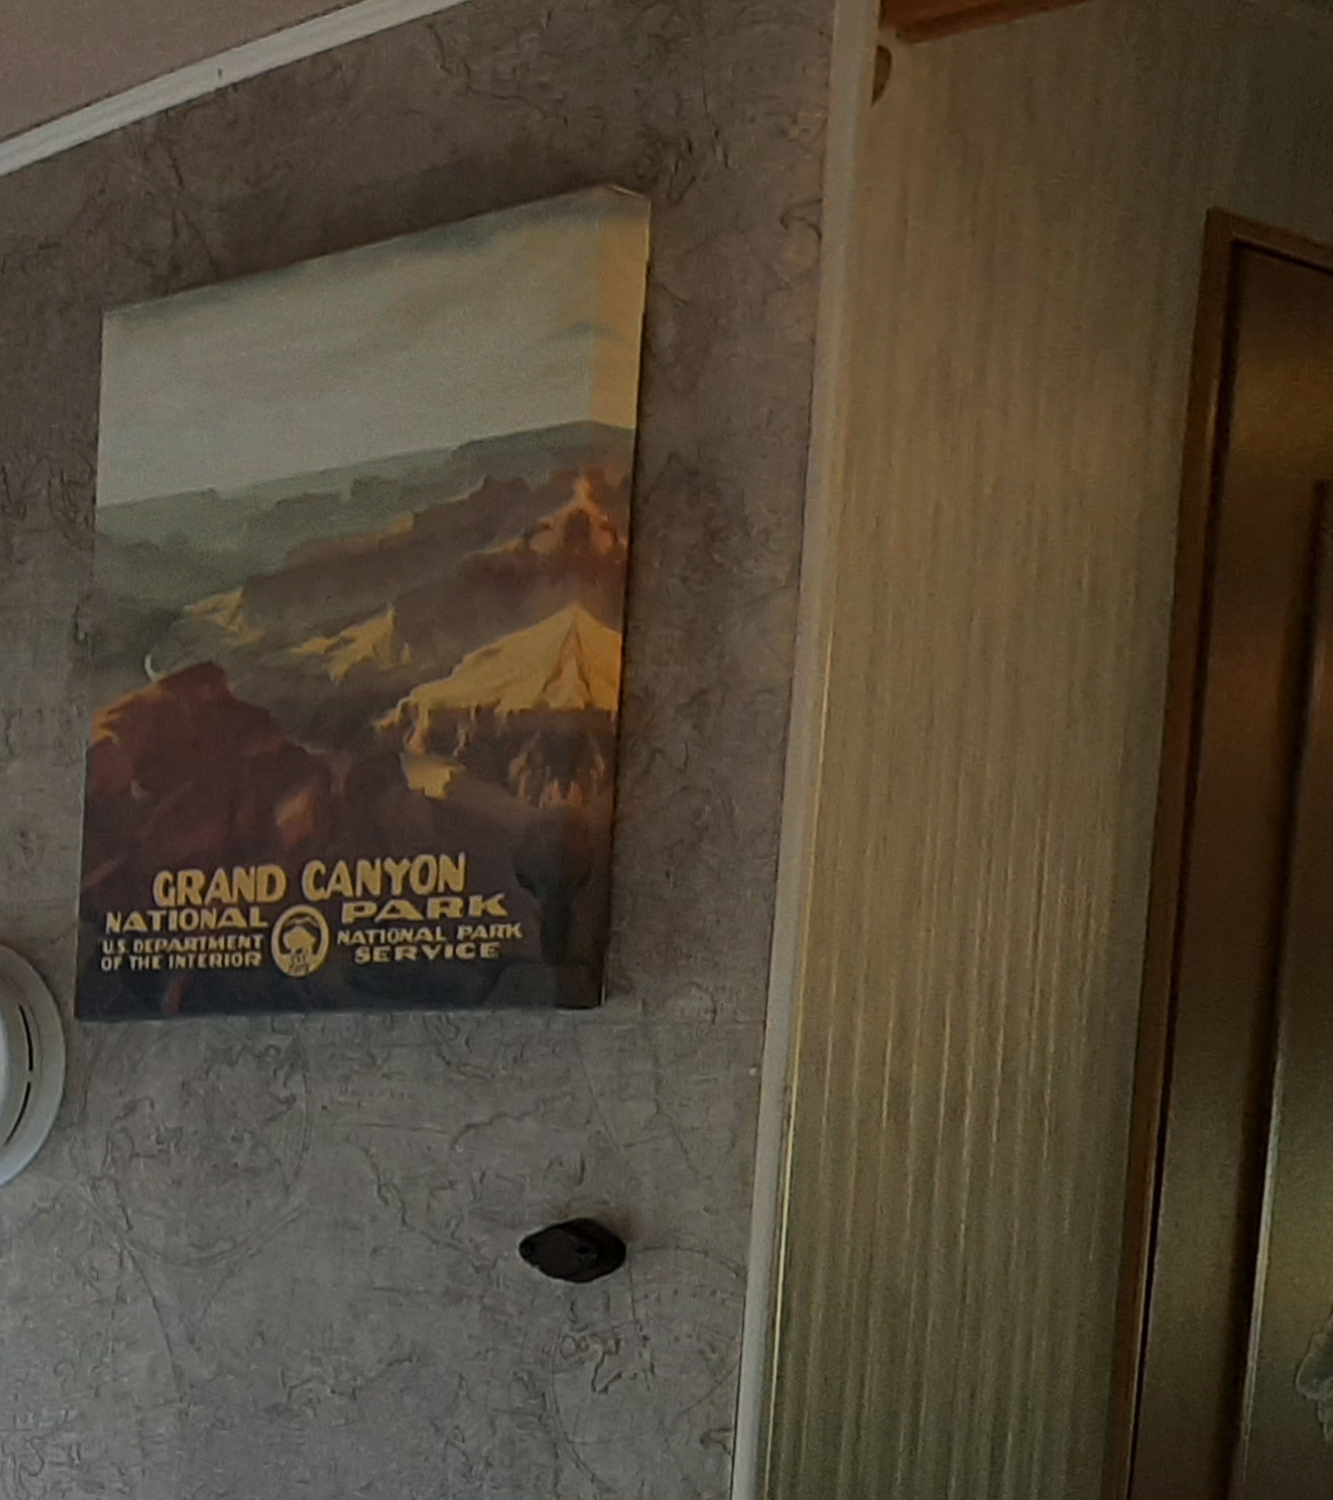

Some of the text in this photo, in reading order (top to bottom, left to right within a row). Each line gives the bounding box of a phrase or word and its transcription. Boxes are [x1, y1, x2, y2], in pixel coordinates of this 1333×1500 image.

[153, 852, 466, 907] GRAND CANYON
[106, 893, 508, 933] NATIONAL PARK
[134, 934, 264, 953] DEPARTMENT
[337, 922, 523, 945] NATIONAL PARK
[101, 952, 262, 972] OF THE INTERIOR
[354, 942, 501, 964] SERVICE
